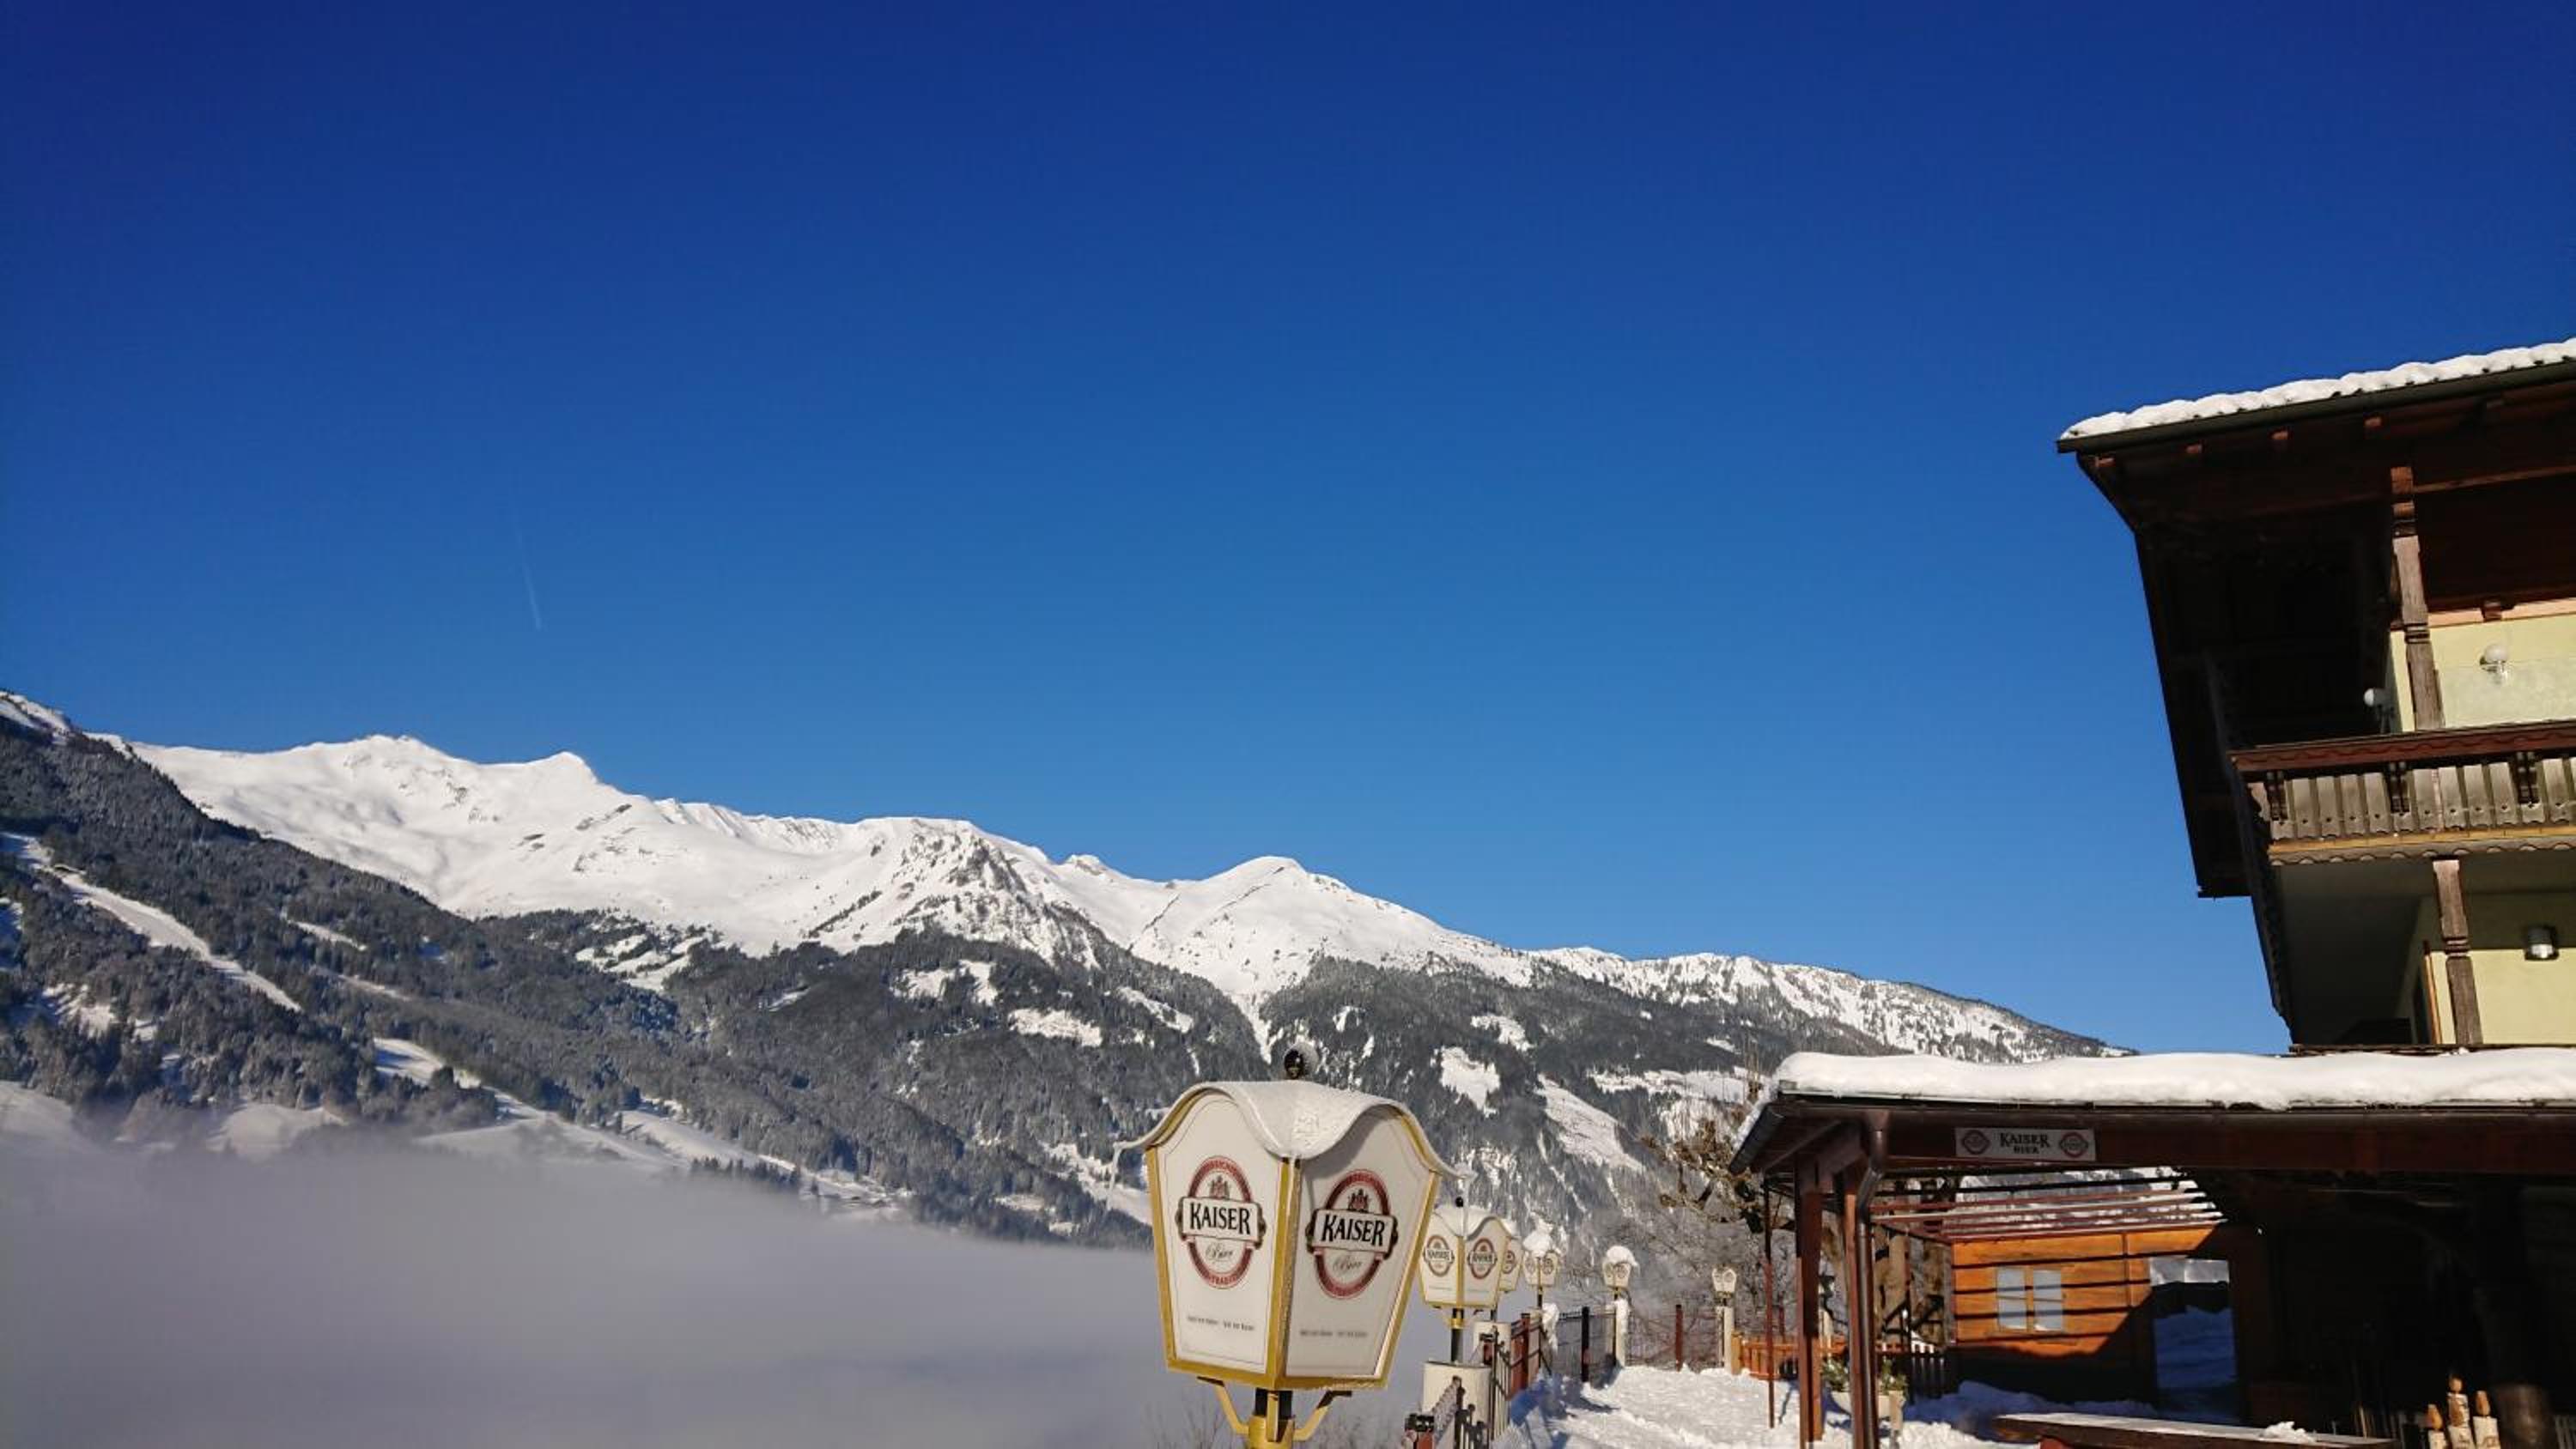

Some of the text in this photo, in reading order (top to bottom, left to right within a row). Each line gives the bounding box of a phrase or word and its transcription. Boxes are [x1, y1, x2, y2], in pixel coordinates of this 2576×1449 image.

[2000, 1132, 2050, 1148] KAISER
[1189, 1203, 1252, 1235] KAISER
[1321, 1213, 1385, 1247] KAISER
